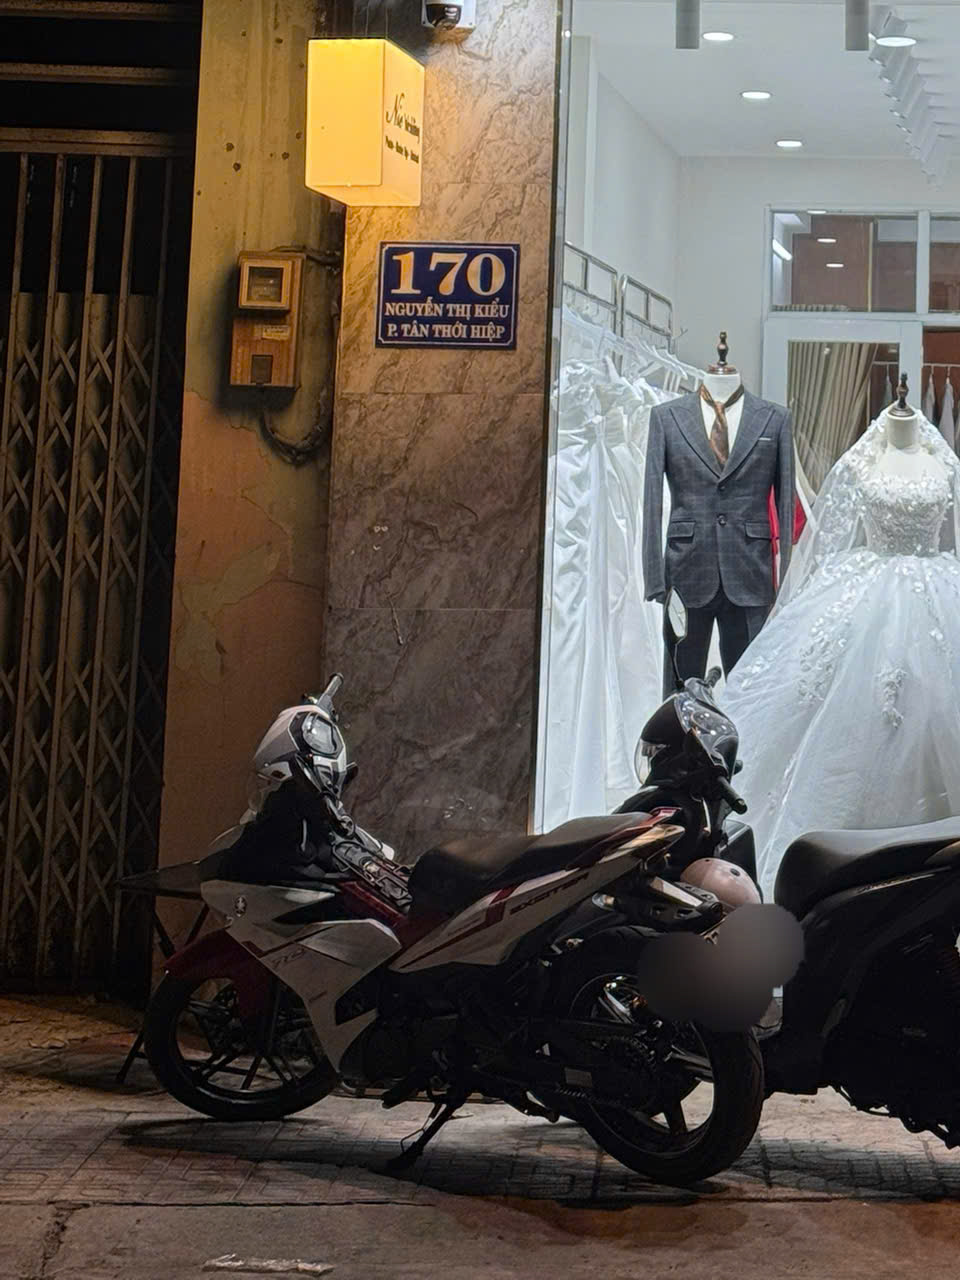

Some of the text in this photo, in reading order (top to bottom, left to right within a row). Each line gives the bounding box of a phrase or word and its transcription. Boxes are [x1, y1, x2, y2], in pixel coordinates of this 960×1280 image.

[390, 251, 506, 296] 170
[384, 296, 510, 321] NGUYỄN THỊ KIỂU
[386, 320, 505, 342] P. TÂN THỚI HIỆP
